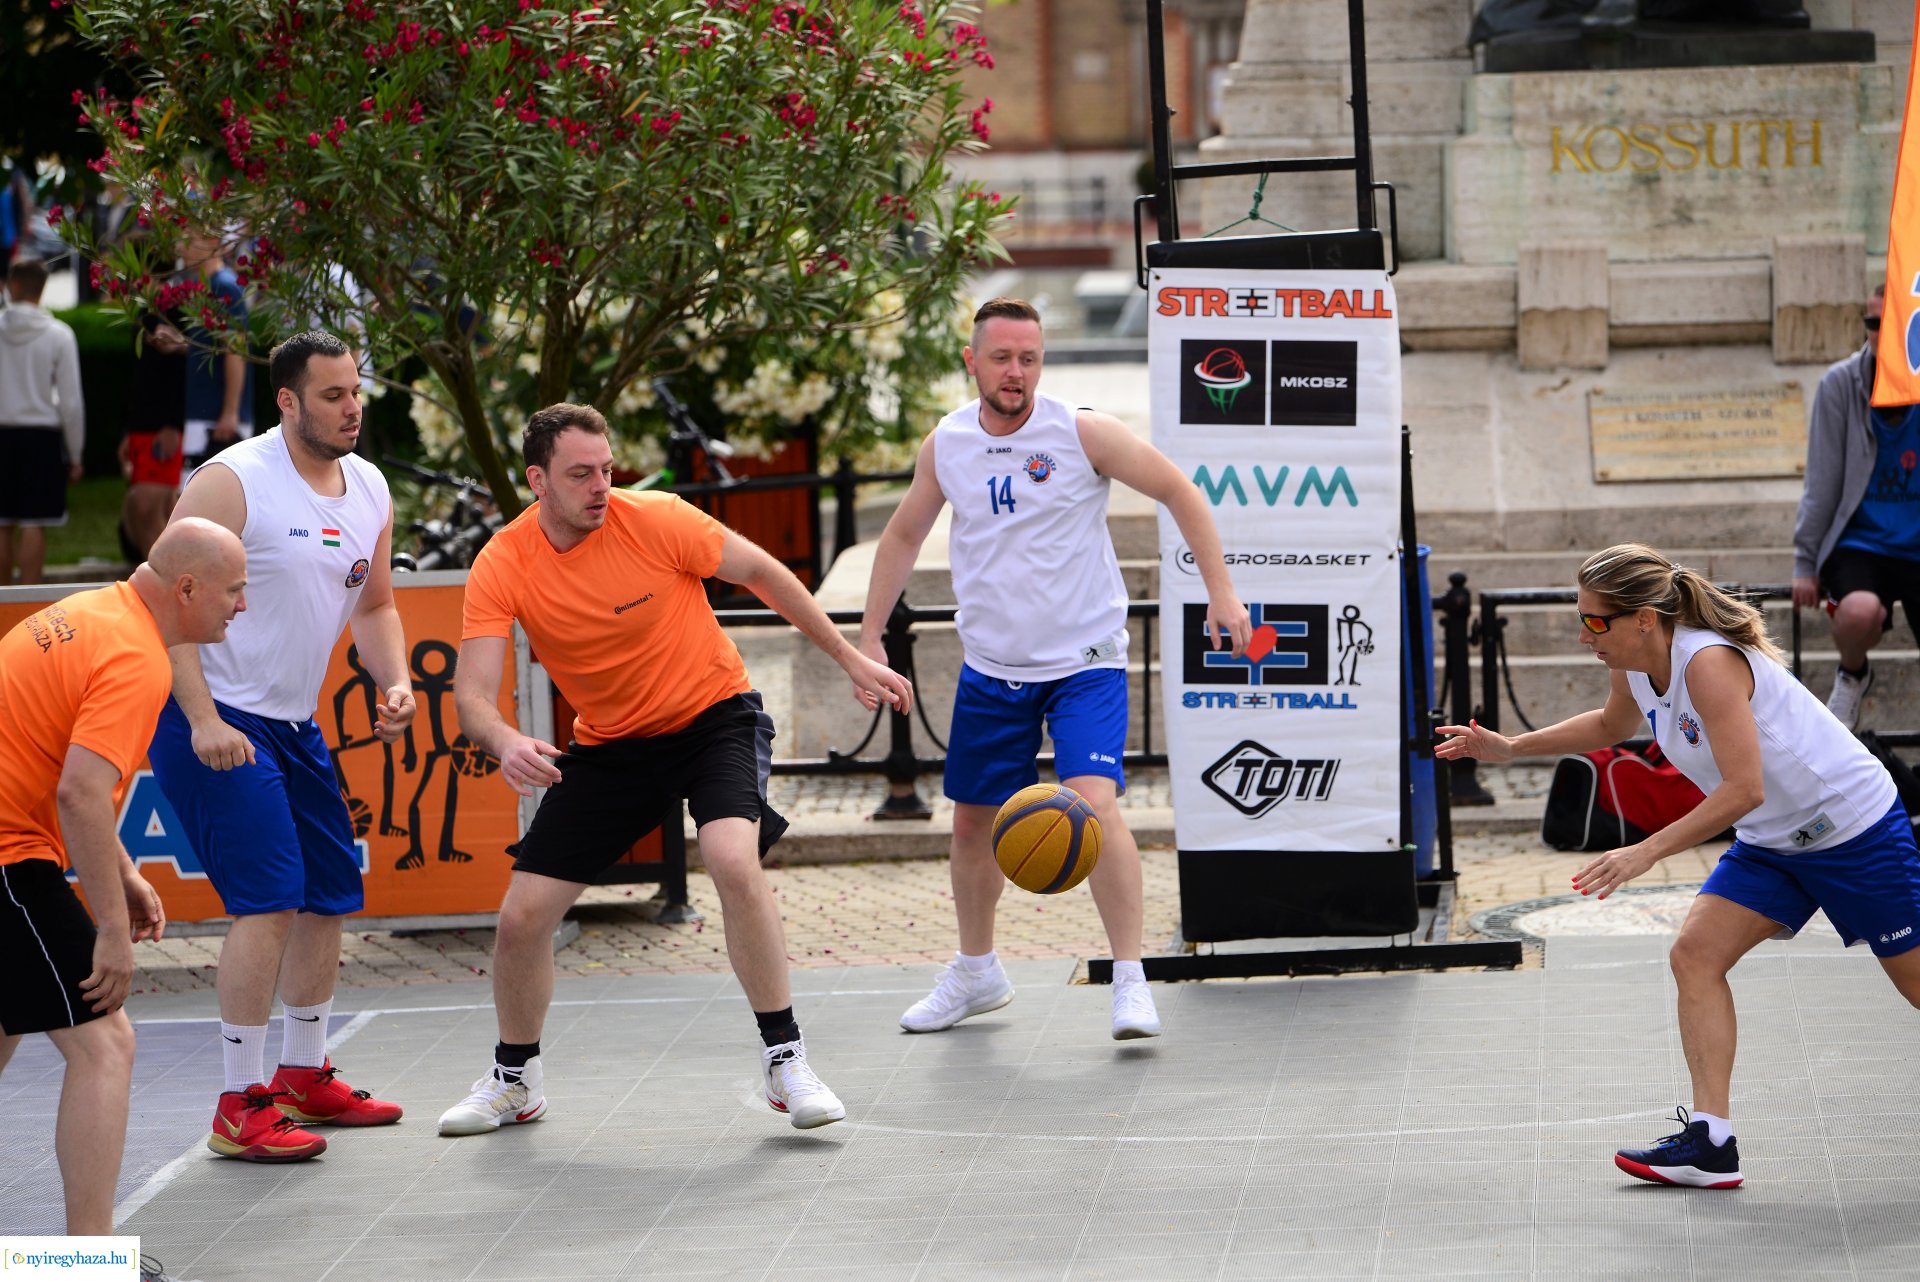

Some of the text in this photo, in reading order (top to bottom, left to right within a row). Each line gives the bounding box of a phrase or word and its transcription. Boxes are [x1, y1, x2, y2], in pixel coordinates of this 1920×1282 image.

[1551, 119, 1823, 174] KOSSUTH
[1280, 376, 1348, 388] MKOSZ
[987, 475, 1016, 515] 14
[1193, 465, 1358, 507] MVM
[288, 528, 309, 538] JAKO
[1225, 554, 1371, 566] GROSBASKET
[1233, 758, 1341, 801] TOTI
[1891, 926, 1912, 941] JAKO
